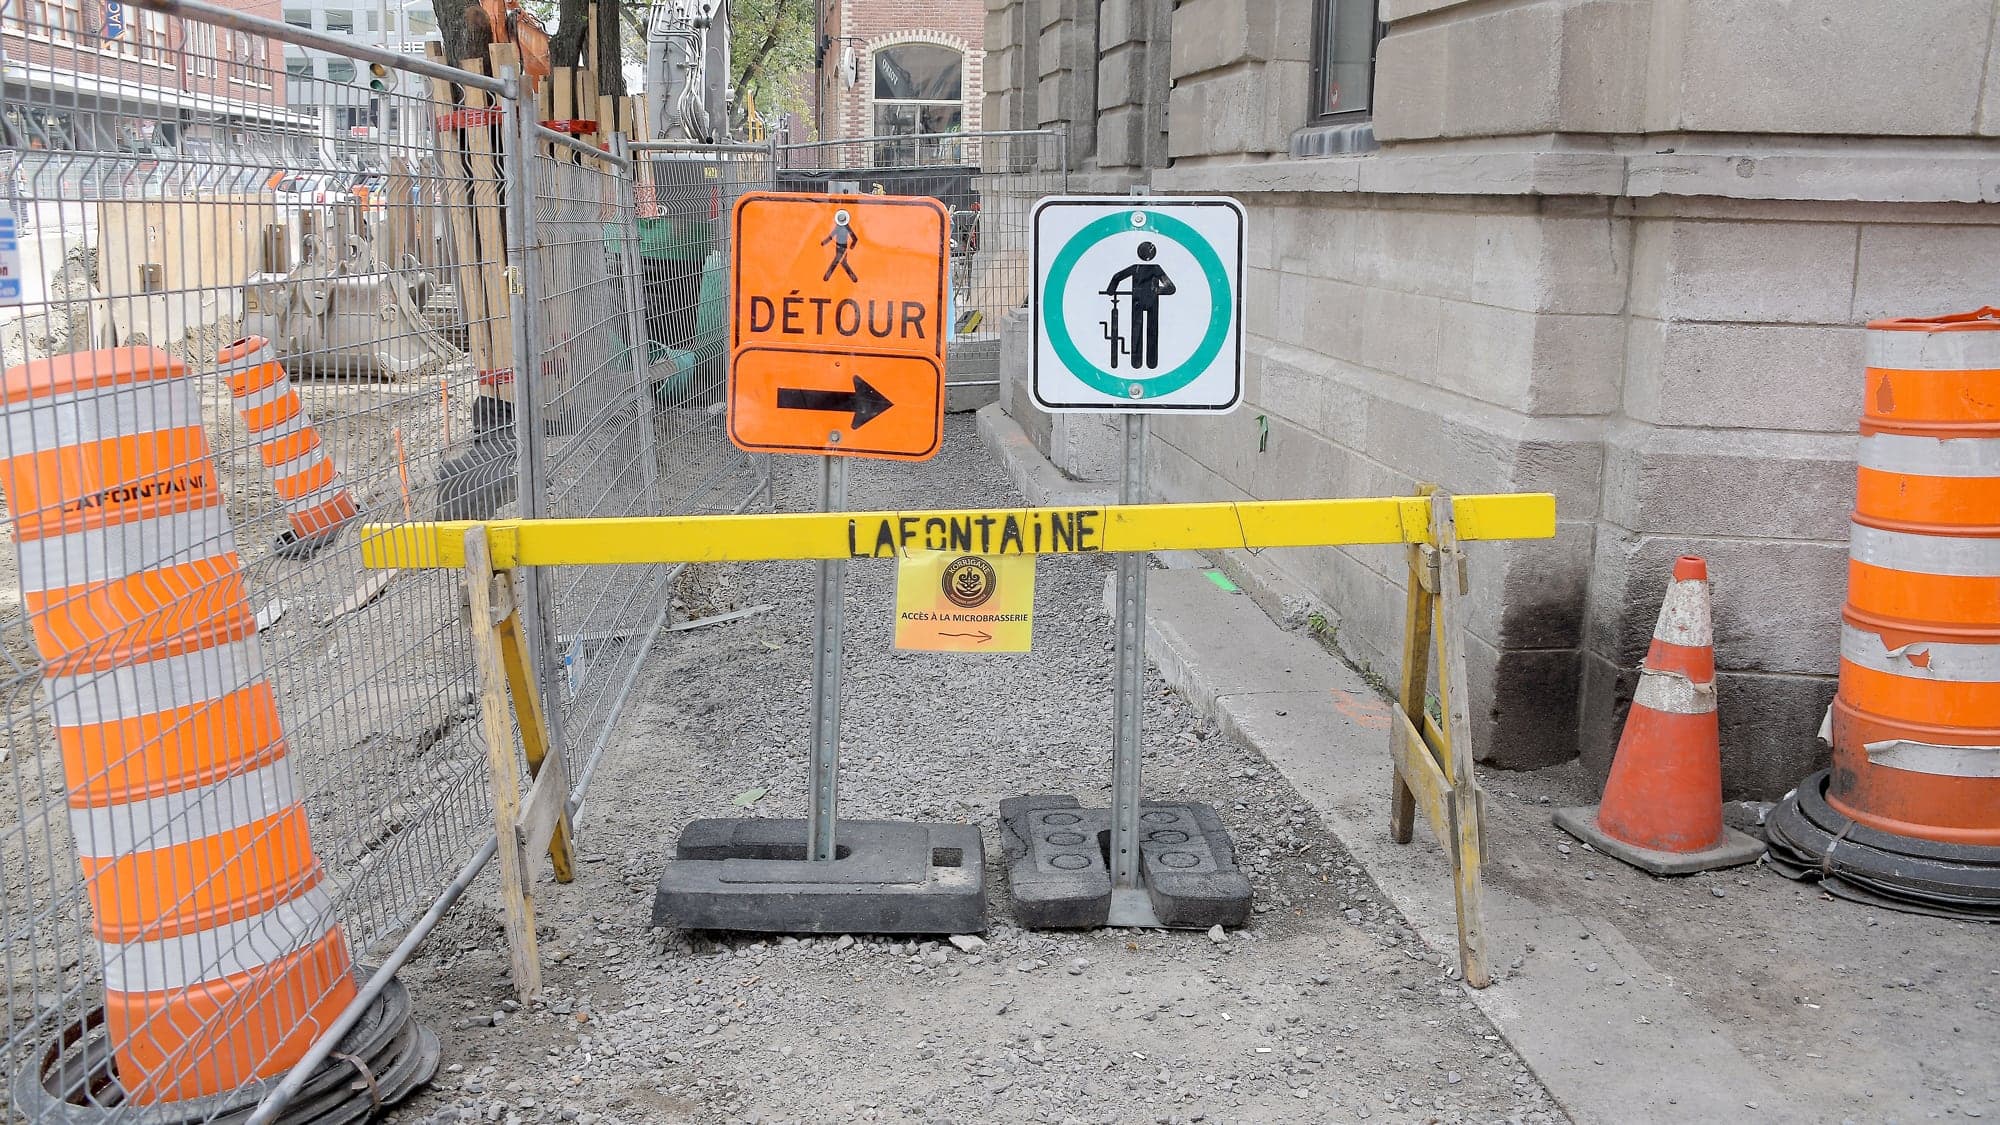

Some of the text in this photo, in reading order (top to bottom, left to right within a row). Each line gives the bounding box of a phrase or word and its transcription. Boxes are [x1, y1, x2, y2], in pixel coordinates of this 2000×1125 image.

[750, 289, 927, 340] DÉTOUR
[901, 611, 1029, 623] ACCÈS À LA MICROBRASSERIE
